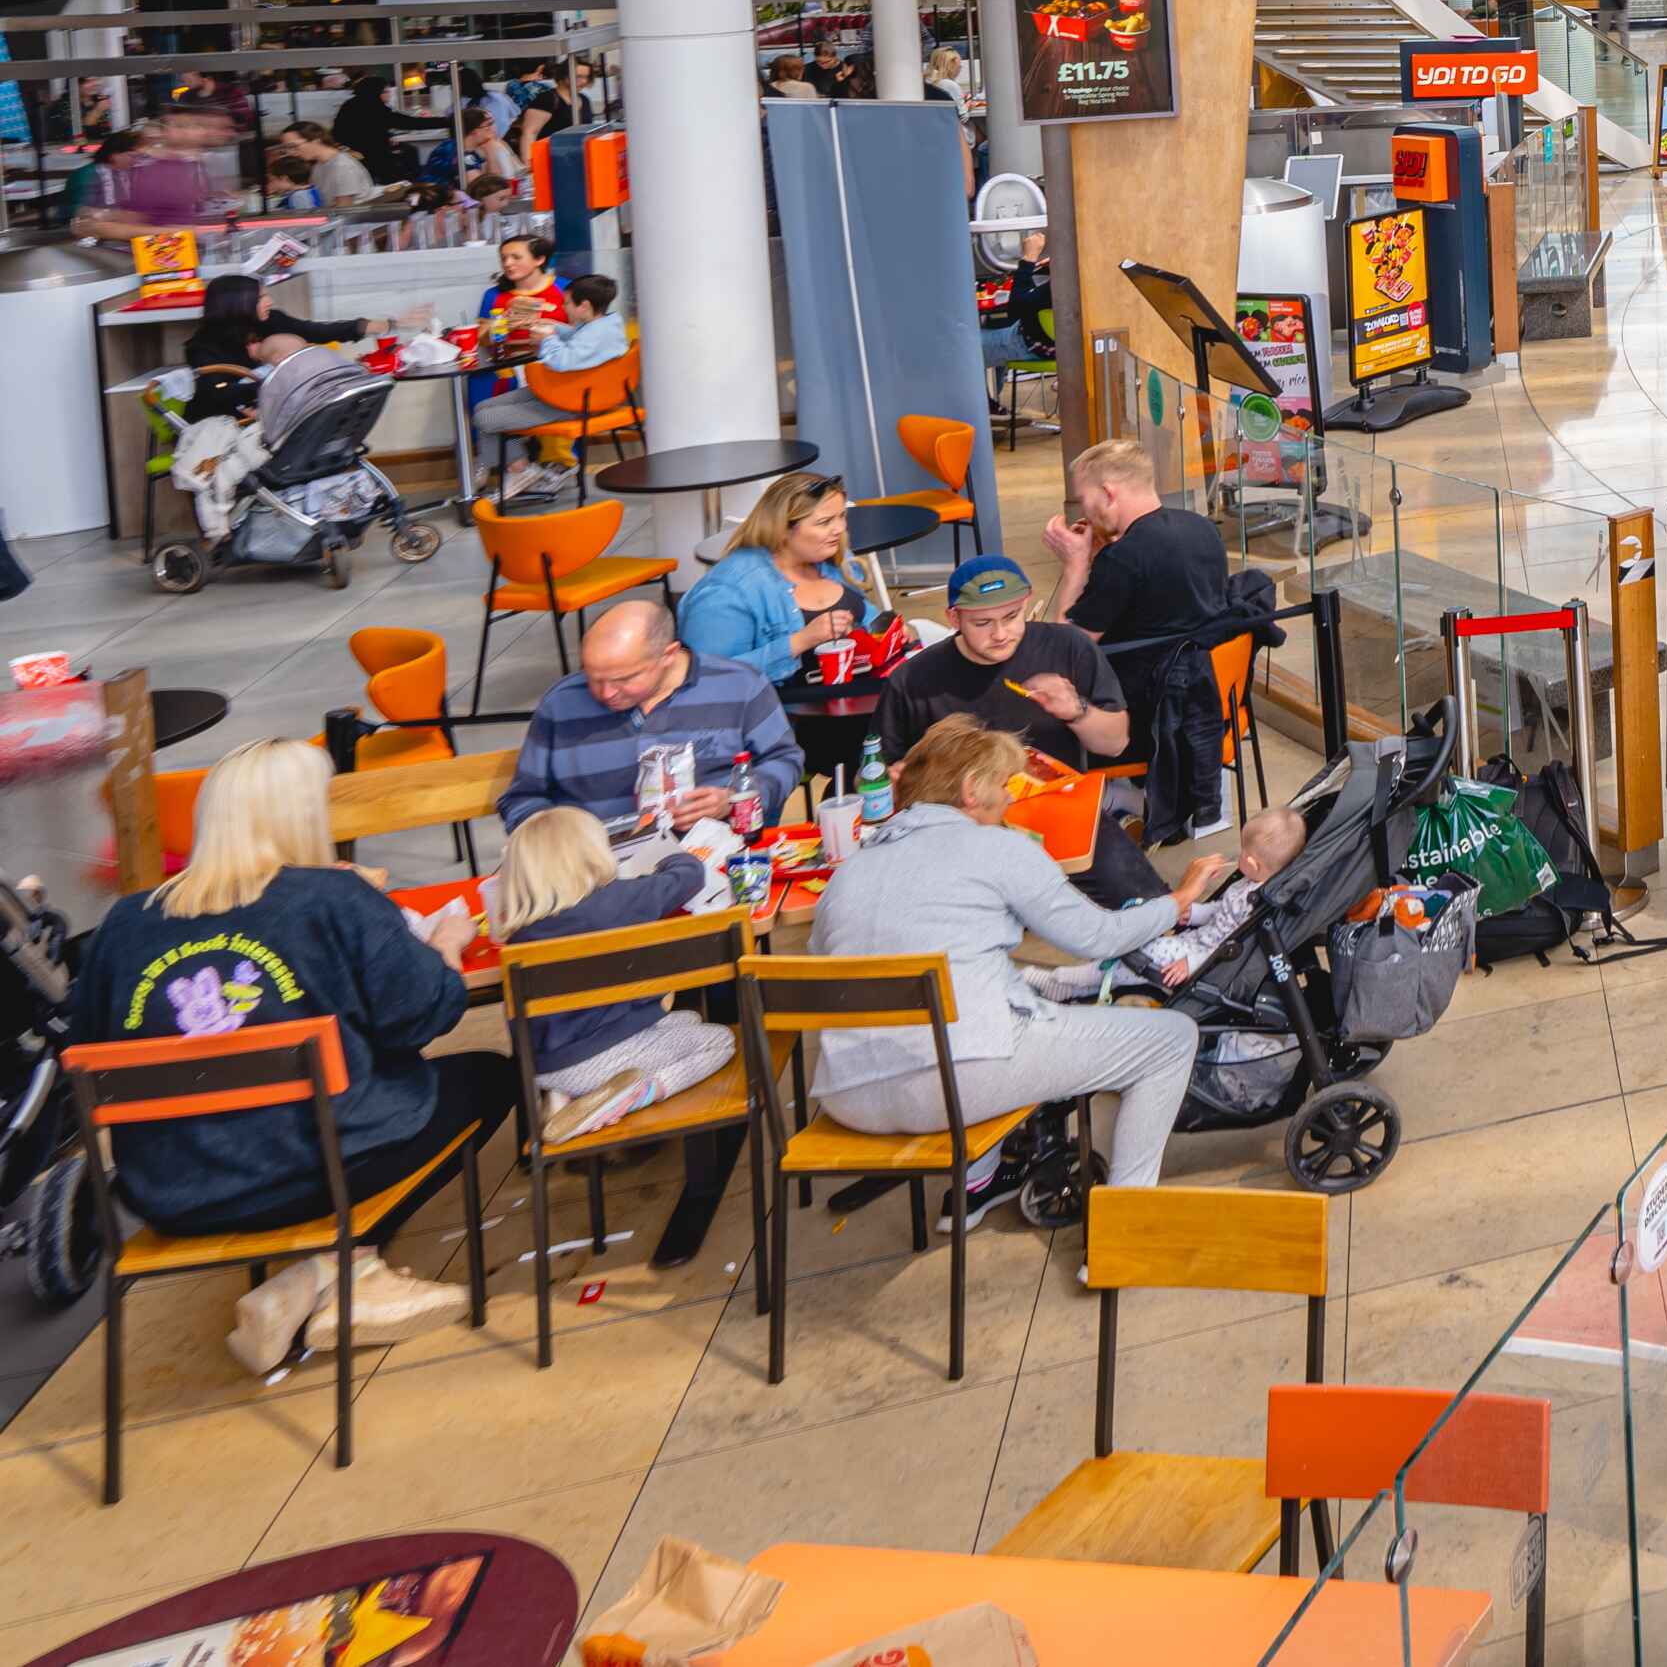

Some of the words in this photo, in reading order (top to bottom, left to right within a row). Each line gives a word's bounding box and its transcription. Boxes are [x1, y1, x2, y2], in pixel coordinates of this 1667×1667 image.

[1056, 60, 1130, 82] £11.75
[1416, 66, 1457, 86] YO!
[1460, 66, 1489, 85] TO
[1491, 65, 1527, 84] GO
[1268, 952, 1293, 983] Joie
